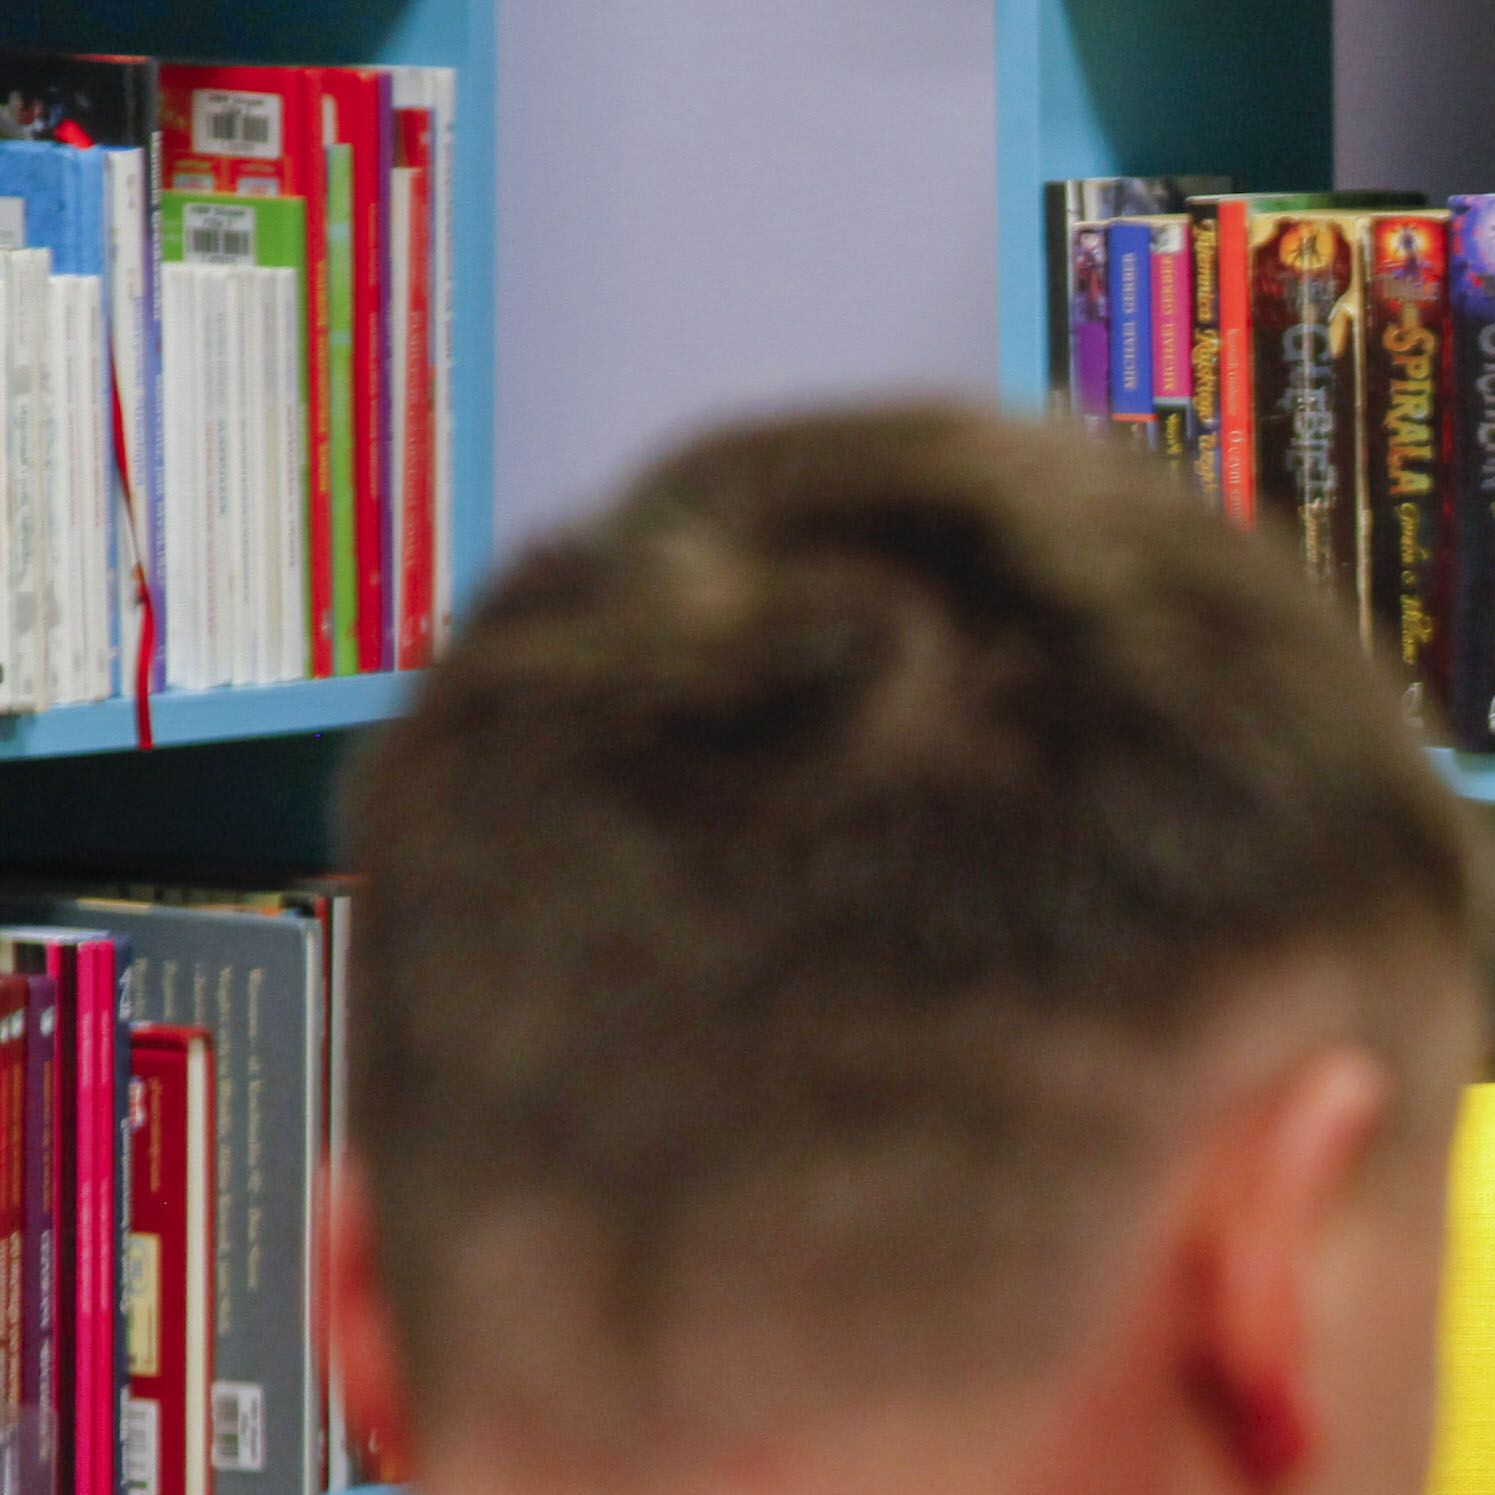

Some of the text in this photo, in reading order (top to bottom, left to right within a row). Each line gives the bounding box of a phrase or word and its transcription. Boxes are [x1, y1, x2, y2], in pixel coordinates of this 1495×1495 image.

[1121, 251, 1137, 390] MICHAEL GERBER
[1160, 255, 1176, 392] MICHAEL GERBER
[1223, 446, 1242, 484] czym
[1382, 324, 1436, 496] SPIRALA
